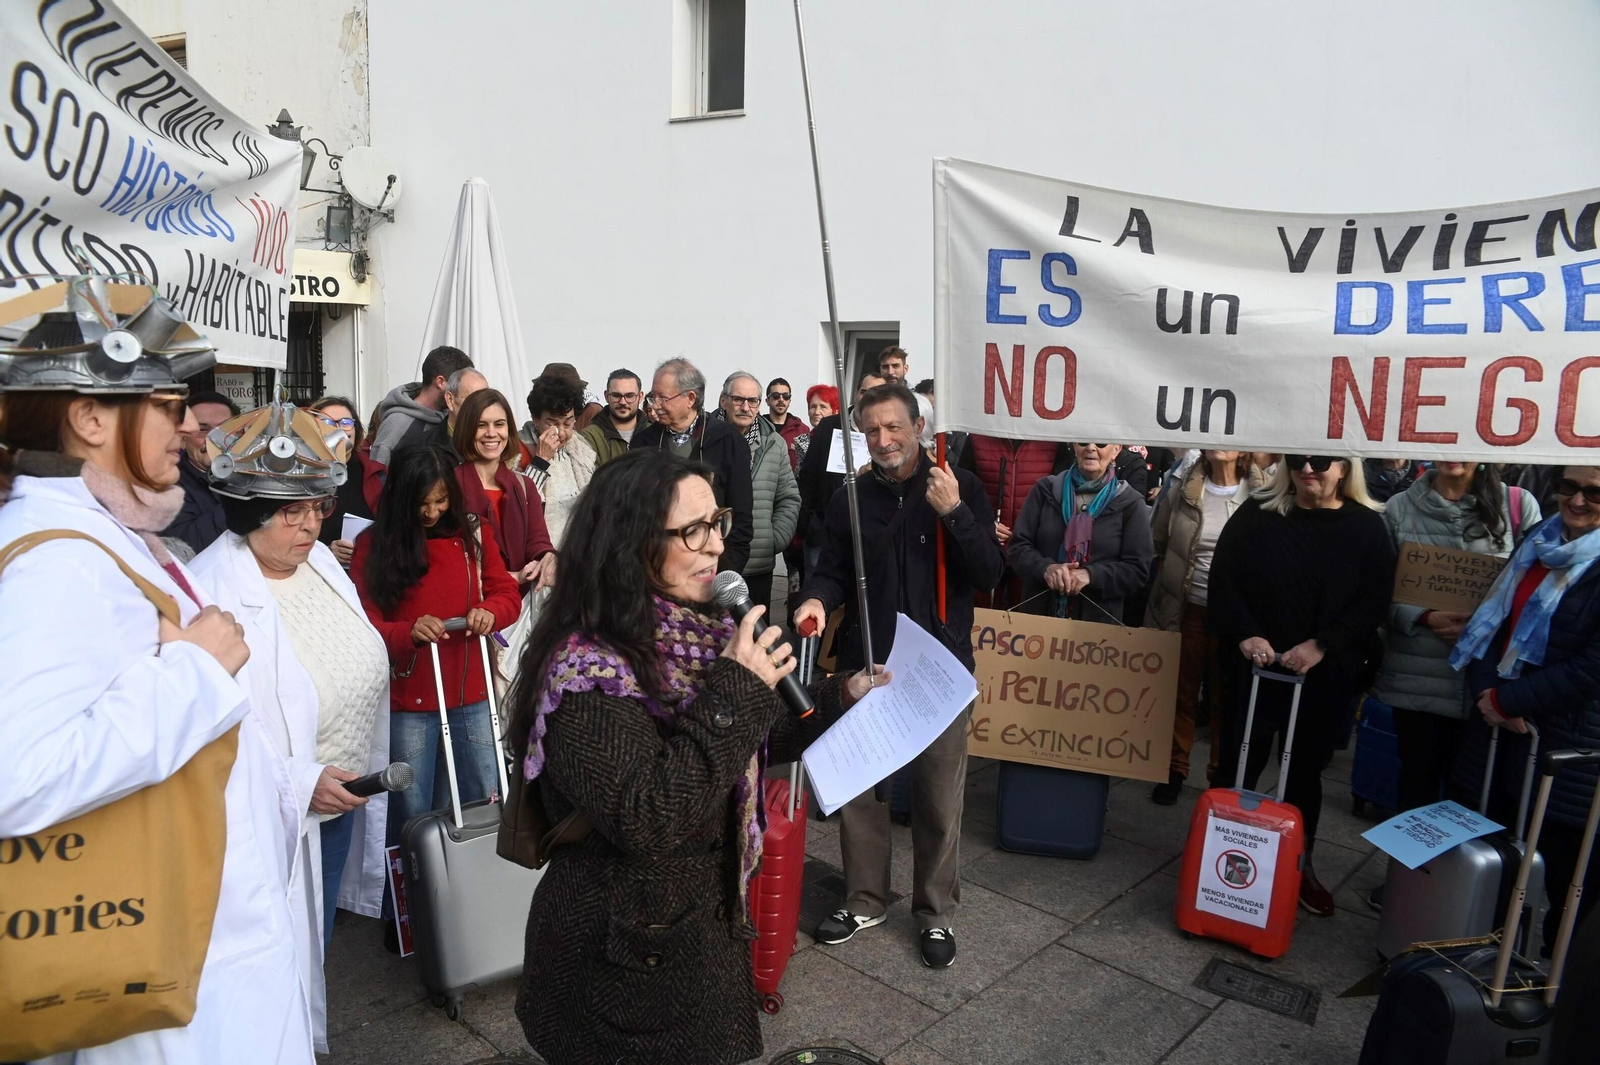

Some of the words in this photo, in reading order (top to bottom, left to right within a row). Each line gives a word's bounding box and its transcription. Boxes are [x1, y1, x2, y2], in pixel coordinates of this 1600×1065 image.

[1059, 195, 1154, 255] LA
[985, 248, 1083, 328] ES
[1156, 287, 1240, 335] un
[226, 387, 255, 398] TORO
[983, 342, 1079, 421] NO
[1157, 385, 1237, 435] un
[1050, 638, 1163, 675] HISTÓRICO
[1001, 724, 1152, 763] EXTINCIÓN
[1223, 835, 1258, 850] SOCIALES
[1231, 829, 1269, 844] VIVIENDAS
[1201, 886, 1226, 899] MENOS
[1227, 893, 1264, 910] VIVIENDAS
[1204, 895, 1259, 916] VACACIONALES
